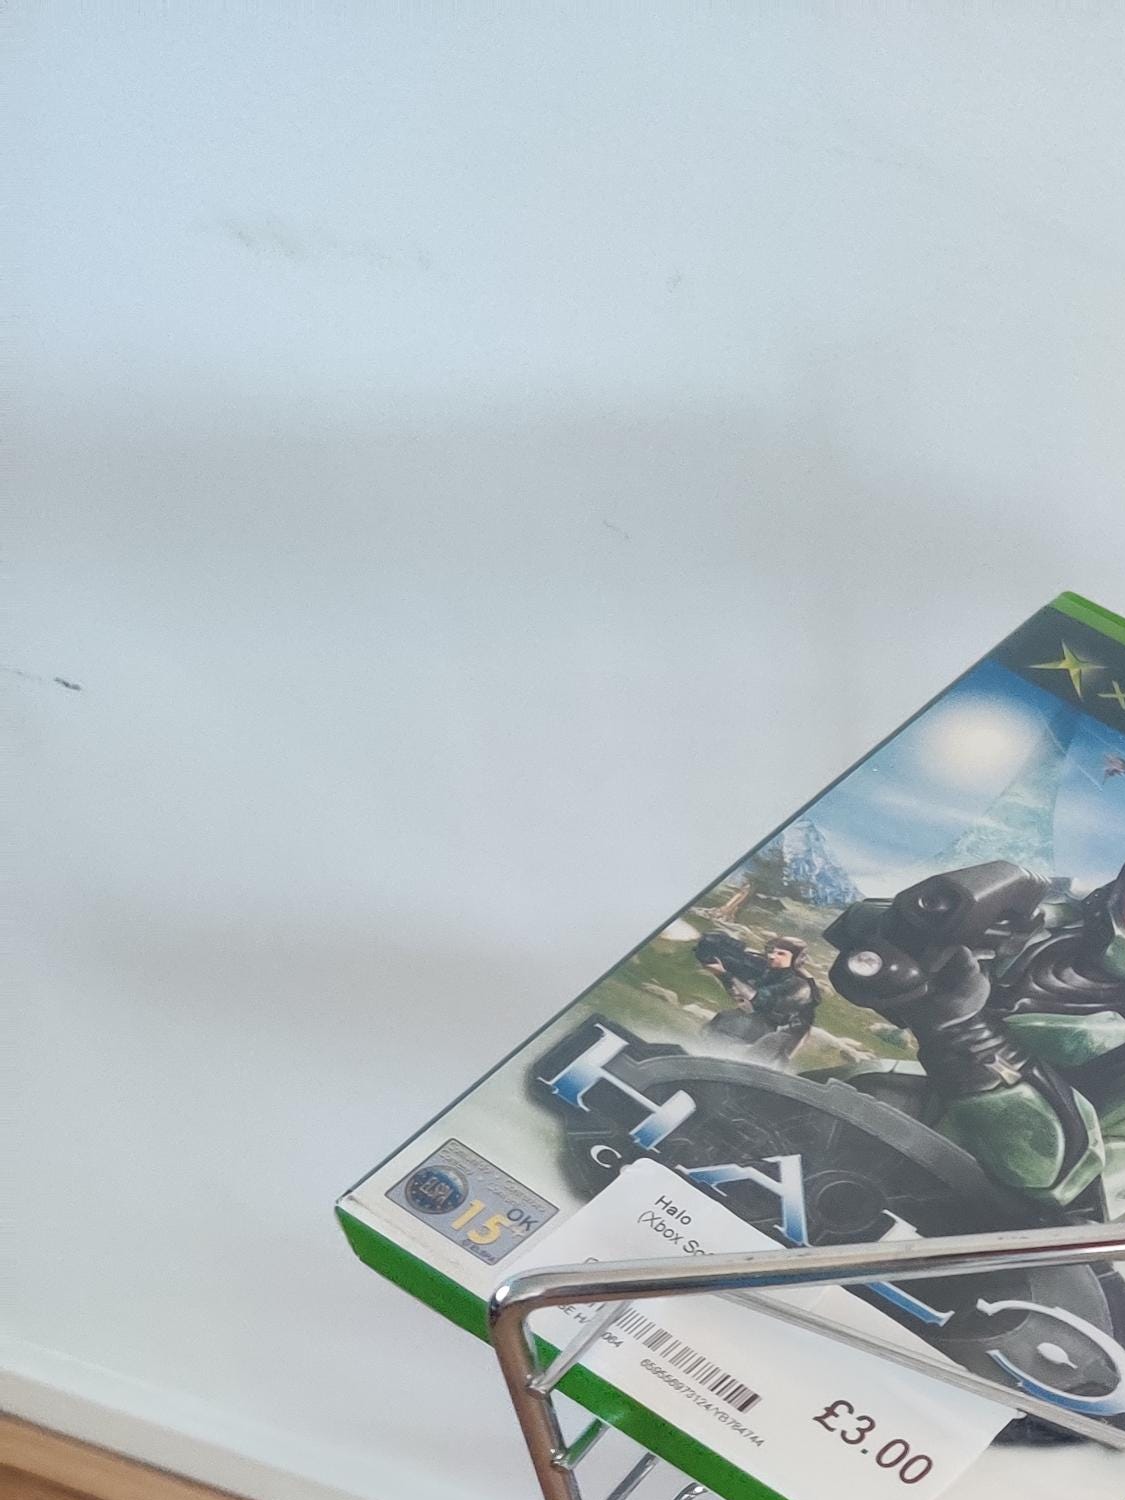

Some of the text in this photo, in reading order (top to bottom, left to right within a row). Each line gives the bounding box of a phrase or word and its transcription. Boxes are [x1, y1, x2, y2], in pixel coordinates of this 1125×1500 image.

[506, 1208, 538, 1231] OK
[654, 1195, 692, 1226] Halo
[637, 1210, 684, 1246] (Xbox
[812, 1400, 933, 1484] £3.00
